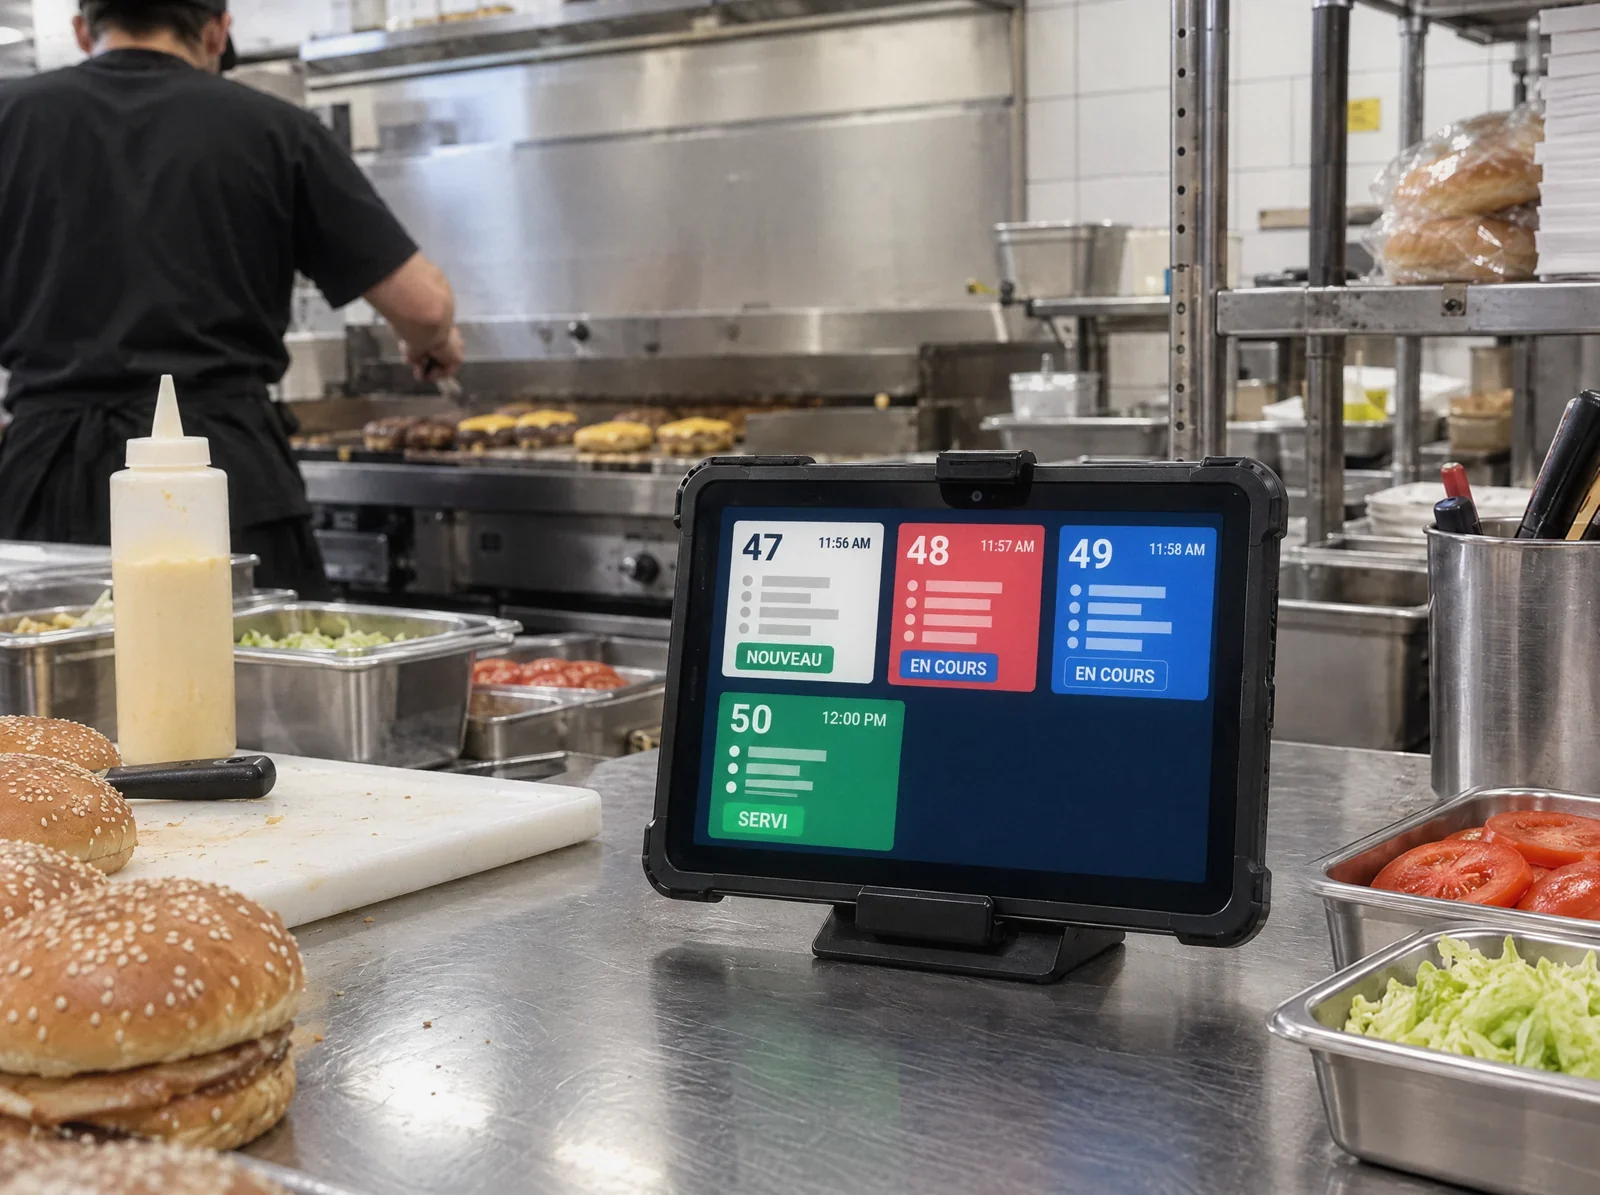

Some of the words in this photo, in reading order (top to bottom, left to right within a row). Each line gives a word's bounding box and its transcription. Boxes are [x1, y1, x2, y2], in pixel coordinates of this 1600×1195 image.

[743, 533, 783, 561] 47
[819, 537, 849, 548] 11:56
[852, 538, 870, 549] AM
[907, 536, 949, 565] 48
[981, 540, 1012, 552] 11:57
[1015, 540, 1034, 552] AM
[1150, 543, 1181, 555] 11:58
[1185, 543, 1205, 555] AM
[1069, 539, 1112, 569] 49
[747, 650, 822, 666] NOUVEAU
[911, 659, 930, 672] EN
[935, 660, 986, 675] COURS
[1076, 666, 1096, 681] EN
[1101, 667, 1154, 683] COURS
[731, 704, 771, 734] 50
[823, 711, 860, 725] 12:00
[864, 713, 886, 726] PM
[738, 811, 787, 829] SERVI
